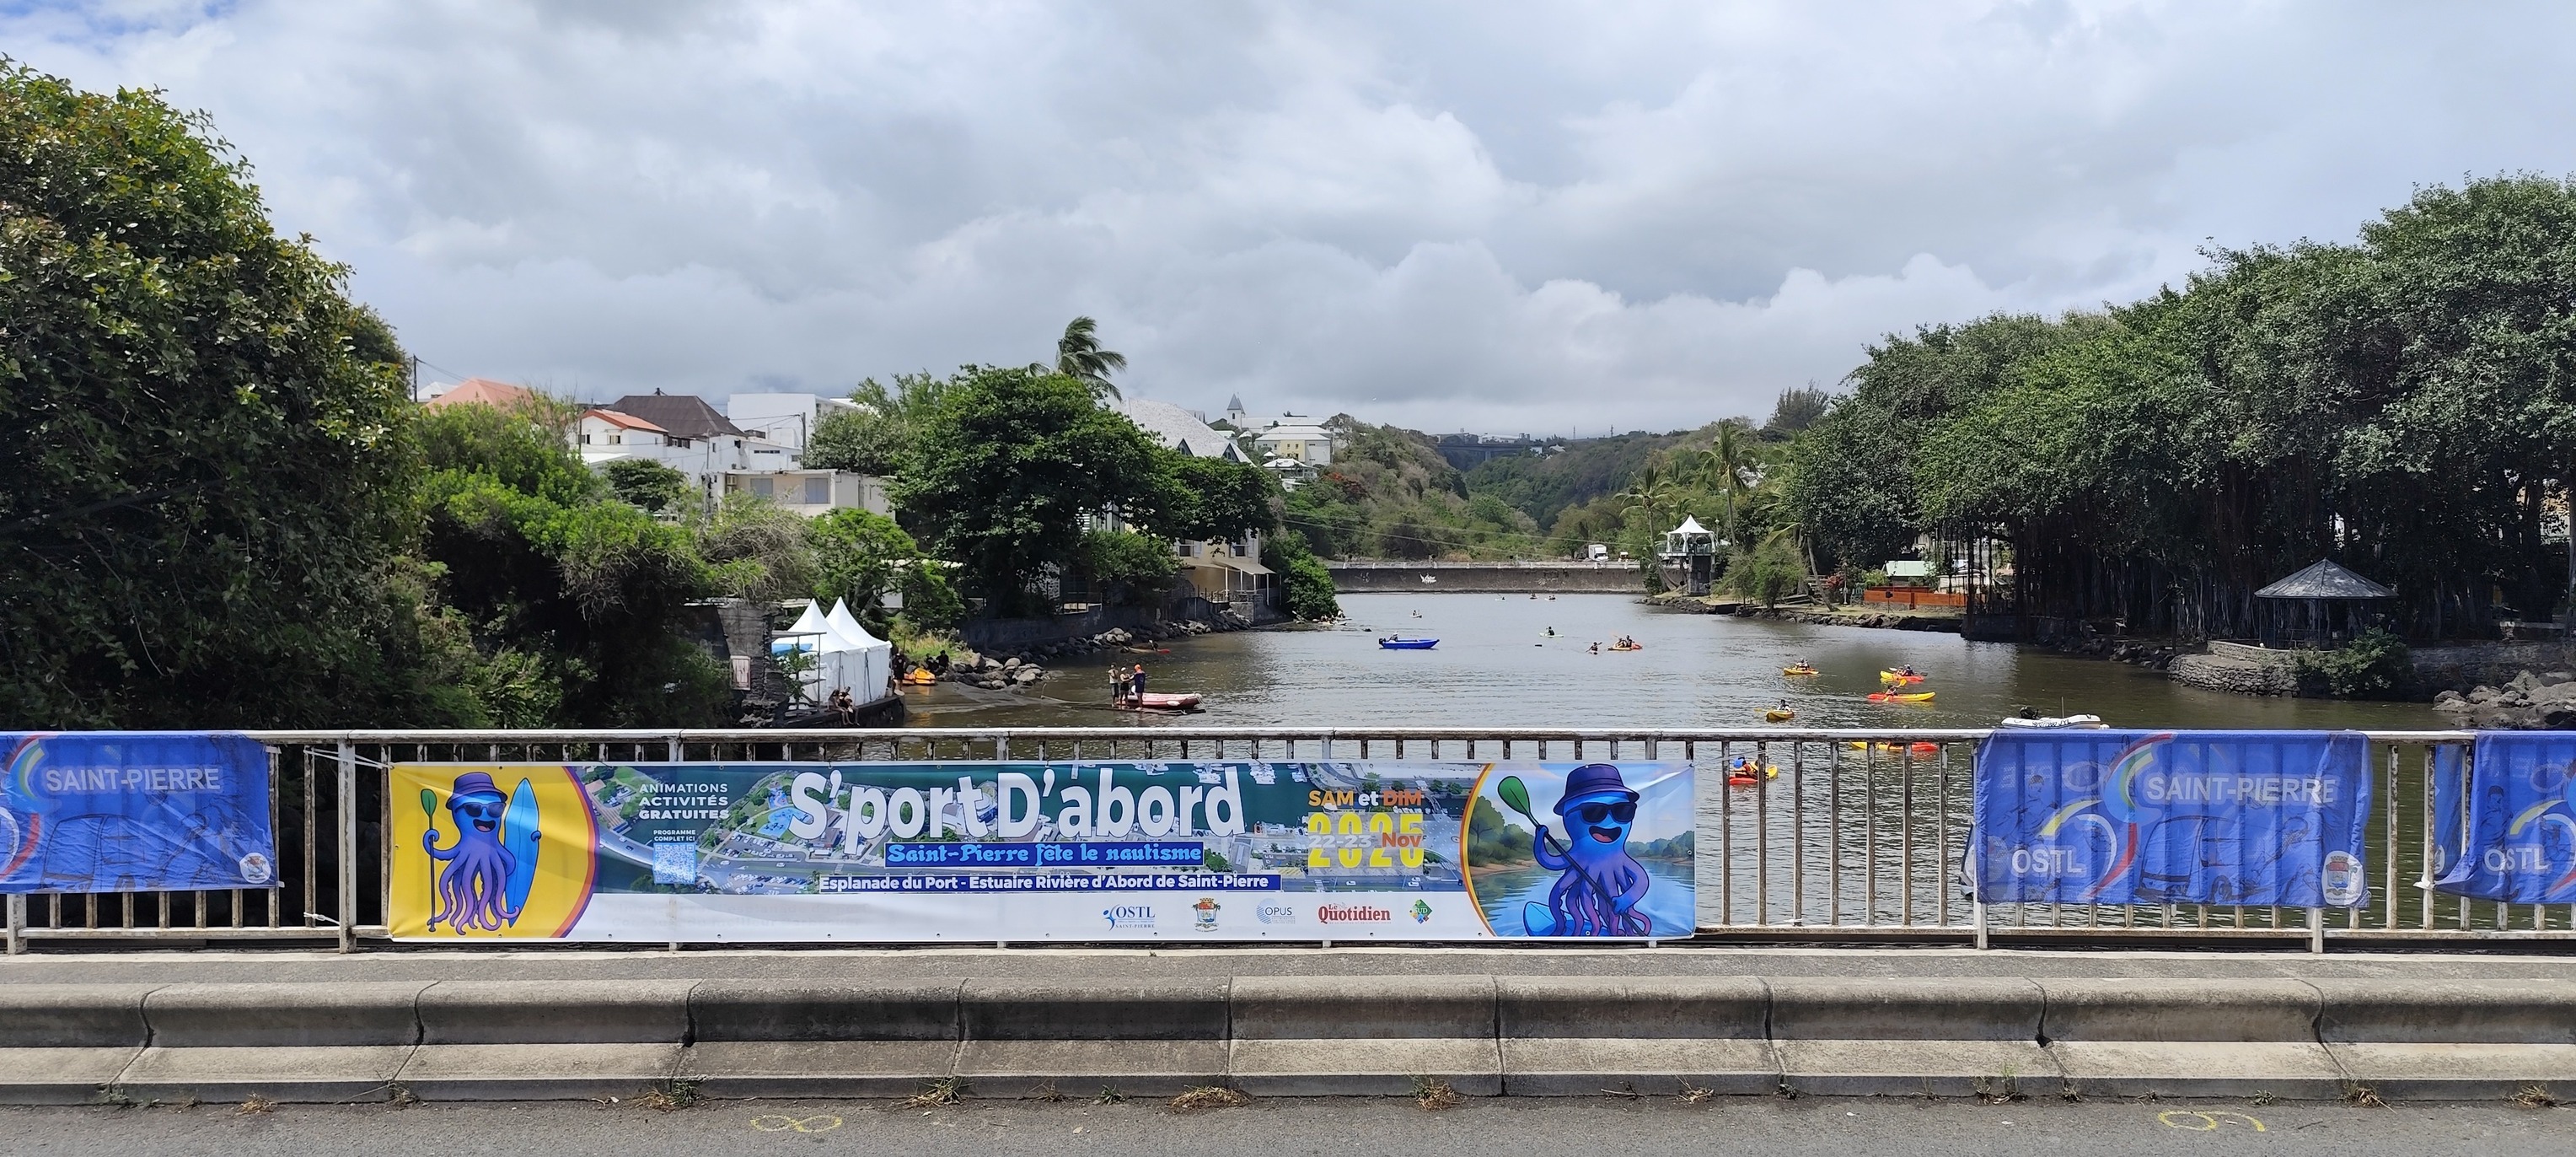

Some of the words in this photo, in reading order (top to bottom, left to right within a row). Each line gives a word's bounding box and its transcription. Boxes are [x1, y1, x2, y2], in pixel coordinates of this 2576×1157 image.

[46, 768, 221, 792] SAINT-PIERRE
[639, 783, 728, 794] ANIMATIONS
[2146, 775, 2335, 803] SAINT-PIERRE
[638, 794, 729, 806] ACTIVITÉS
[1308, 790, 1354, 807] SAM
[1358, 791, 1379, 807] et
[638, 810, 730, 820] GRATUITES
[788, 769, 989, 855] S'port
[997, 766, 1245, 837] D'abord
[1308, 834, 1372, 848] 22-23
[1382, 832, 1423, 848] Nov
[887, 844, 1029, 863] Saint-Pierre
[1035, 843, 1074, 867] fête
[1080, 843, 1098, 861] le
[1106, 843, 1201, 861] nautisme
[2011, 849, 2086, 877] OSTL
[2484, 848, 2551, 871] OSTL
[820, 876, 899, 892] Esplanade
[902, 876, 922, 890] du
[926, 876, 958, 889] Port
[969, 876, 1033, 889] Estuaire
[1036, 875, 1089, 889] Rivière
[1092, 875, 1156, 889] d'Abord
[1157, 875, 1175, 889] de
[1178, 874, 1269, 889] Saint-Pierre
[1116, 906, 1156, 918] OSTL
[1264, 907, 1292, 916] OPUS
[1318, 905, 1392, 924] Quotidien
